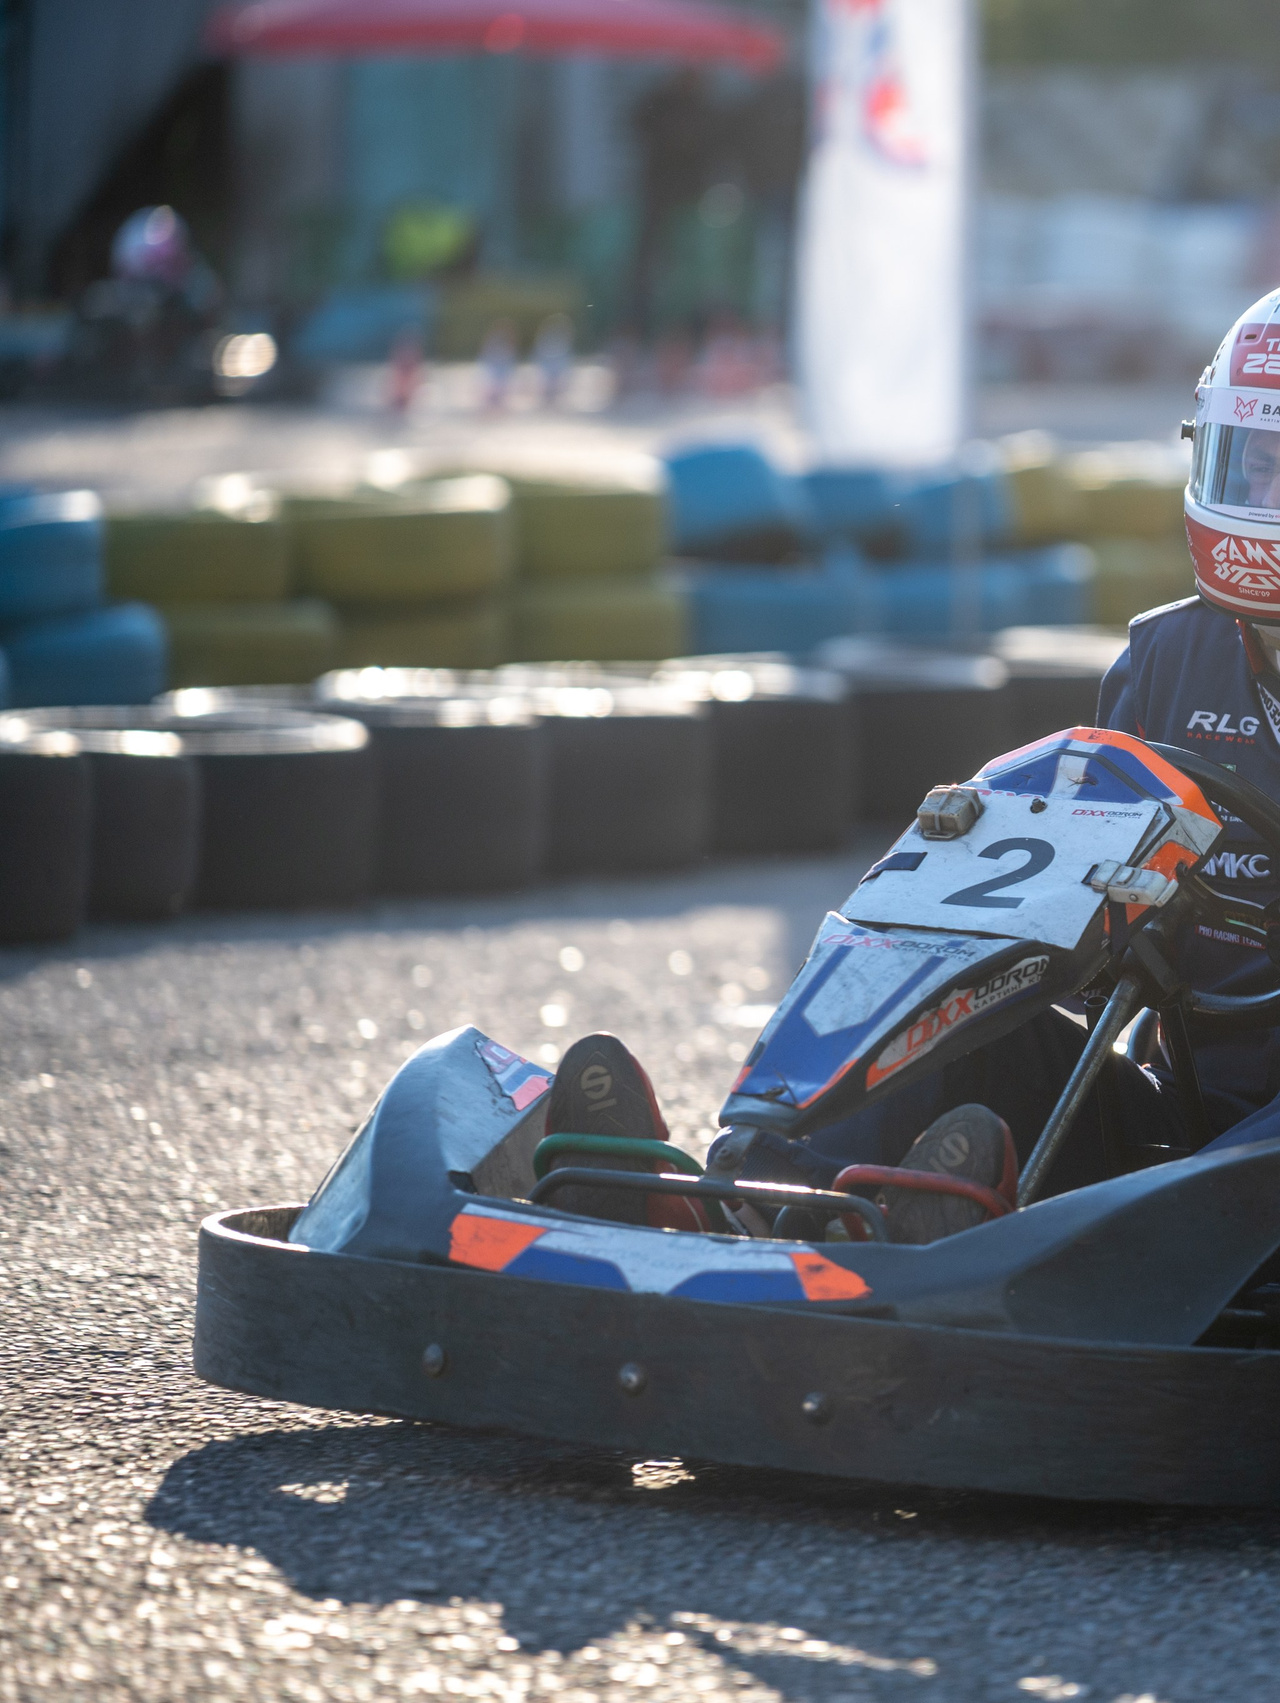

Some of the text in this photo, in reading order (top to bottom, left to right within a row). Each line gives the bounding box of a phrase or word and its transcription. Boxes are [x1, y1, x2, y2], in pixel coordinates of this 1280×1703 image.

[1186, 710, 1260, 736] RLG
[940, 837, 1056, 909] 2
[1198, 924, 1212, 937] PRO
[1213, 928, 1240, 943] RACING
